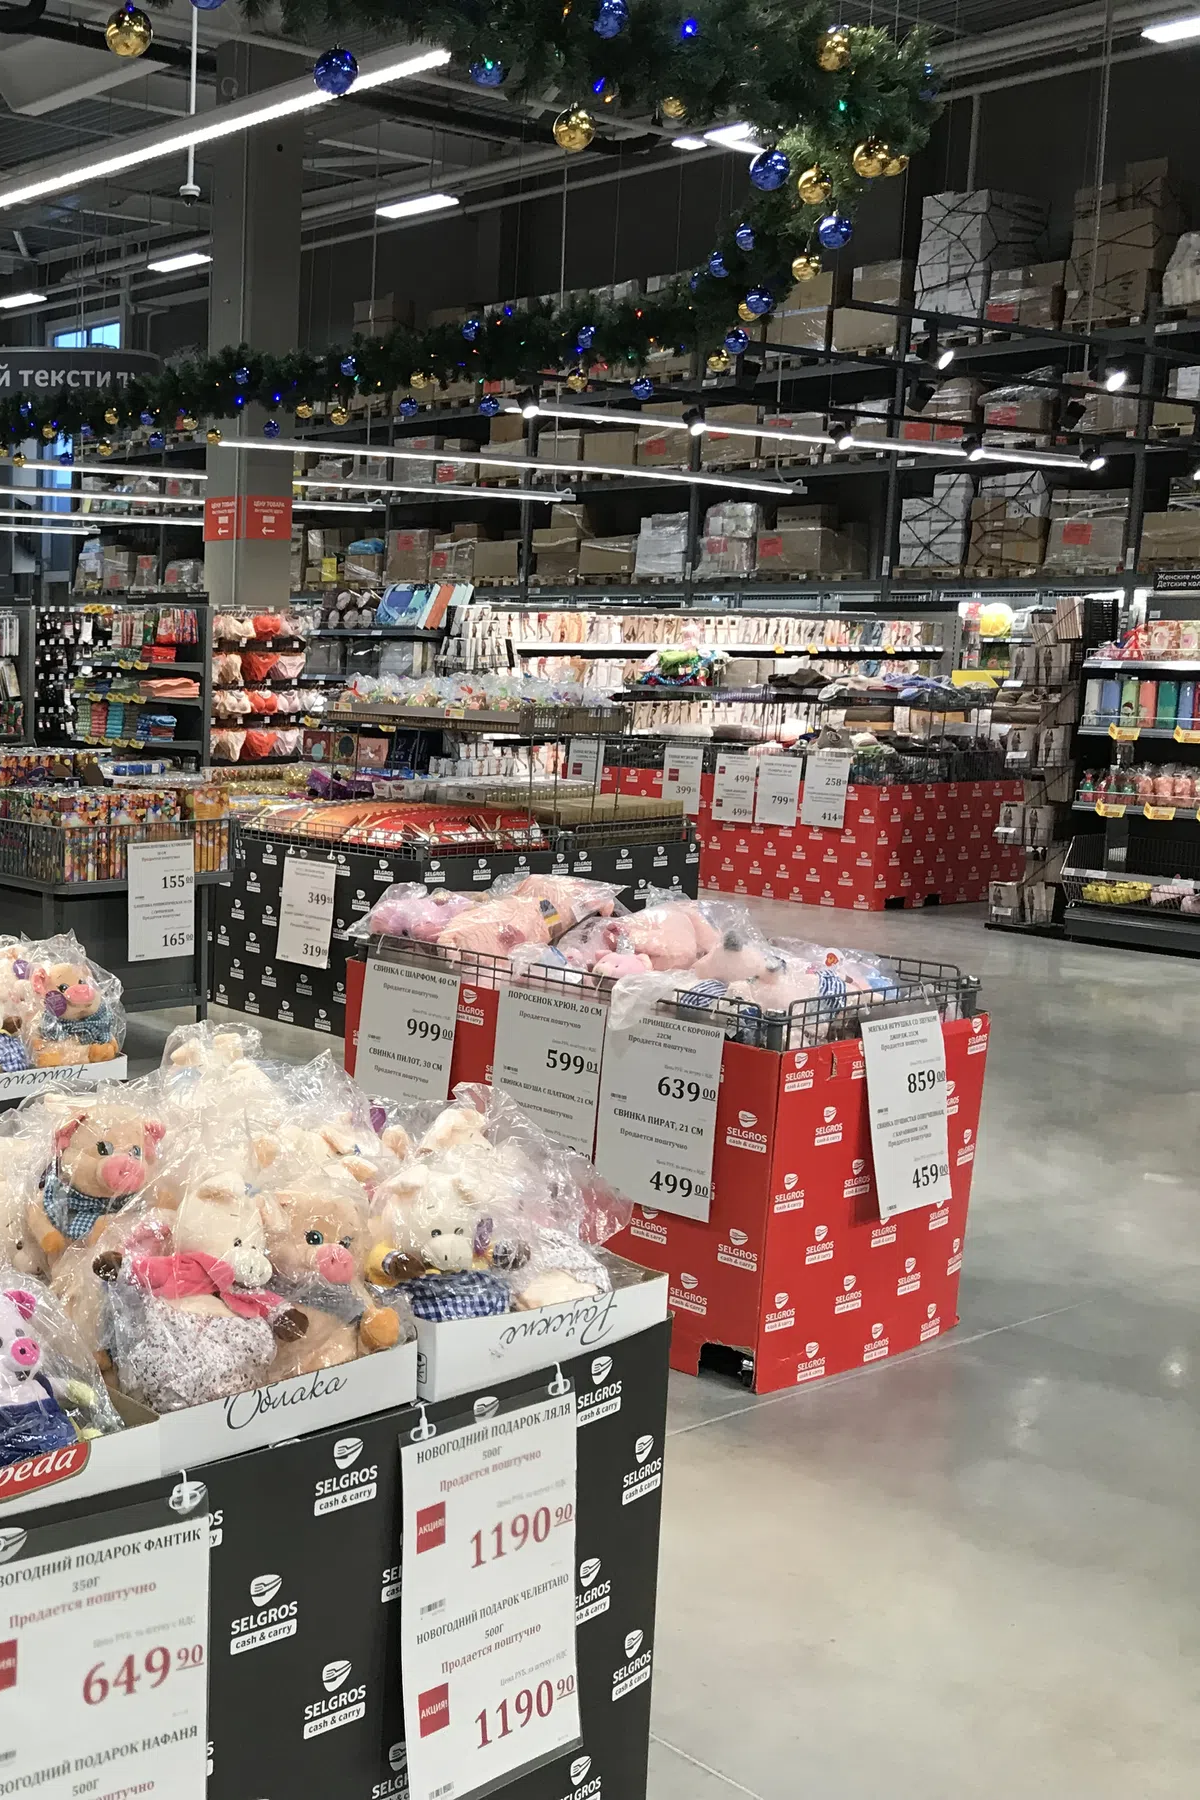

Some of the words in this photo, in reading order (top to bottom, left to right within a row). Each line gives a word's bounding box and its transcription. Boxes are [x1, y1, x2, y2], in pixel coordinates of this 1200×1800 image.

[19, 369, 135, 388] тексти
[1157, 580, 1187, 588] Детские
[825, 778, 841, 786] 258
[772, 796, 788, 805] 799
[162, 874, 185, 889] 155
[308, 892, 327, 906] 349
[163, 932, 185, 947] 165
[302, 943, 321, 957] 319
[374, 964, 399, 975] СВИНКА
[405, 970, 437, 984] ШАРФОМ,
[438, 977, 446, 985] 40
[448, 979, 457, 987] СМ
[508, 990, 552, 1007] ПОРОСЕНОК
[553, 1000, 578, 1012] ХРЮН,
[580, 1004, 589, 1014] 20
[591, 1007, 602, 1017] СМ
[407, 1018, 440, 1041] 999
[442, 1029, 453, 1040] 00
[519, 1010, 550, 1023] Продается
[551, 1017, 581, 1029] поштучно
[643, 1018, 681, 1031] ПРИНЦЕССА
[688, 1026, 721, 1039] КОРОНОЙ
[628, 1035, 662, 1047] Продается
[369, 1047, 395, 1060] СВИНКА
[397, 1054, 421, 1067] ПИЛОТ,
[423, 1060, 431, 1068] 30
[432, 1063, 442, 1072] СМ
[546, 1049, 584, 1075] 599
[586, 1061, 599, 1074] 01
[785, 1069, 814, 1081] SELGROS
[908, 1069, 935, 1093] 859
[937, 1071, 946, 1082] 00
[500, 1077, 522, 1088] СВИНКА
[523, 1082, 542, 1093] ШУША
[547, 1088, 576, 1102] ПЛАТКОМ,
[577, 1096, 584, 1104] 21
[585, 1098, 594, 1106] СМ
[658, 1076, 700, 1102] 639
[702, 1088, 716, 1101] 00
[614, 1108, 646, 1122] СВИНКА
[648, 1116, 678, 1131] ПИРАТ,
[679, 1124, 688, 1132] 21
[691, 1126, 703, 1136] СМ
[620, 1128, 653, 1142] Продается
[655, 1137, 687, 1150] поштучно
[727, 1126, 768, 1143] SELGROS
[748, 1142, 764, 1151] carry
[650, 1171, 692, 1198] 499
[694, 1185, 709, 1198] 00
[913, 1164, 938, 1188] 459
[940, 1164, 948, 1177] 00
[718, 1243, 758, 1262] SELGROS
[765, 1308, 795, 1322] SELGROS
[223, 1374, 348, 1430] Облака
[577, 1380, 622, 1409] SELGROS
[417, 1427, 489, 1464] НОВОГОДНИЙ
[491, 1413, 541, 1437] ПОДАРОК
[543, 1402, 571, 1422] ЛЯЛЯ
[315, 1465, 378, 1497] SELGROS
[440, 1465, 490, 1493] Продается
[492, 1450, 541, 1473] поштучно
[623, 1457, 662, 1488] SELGROS
[319, 1498, 339, 1511] cash
[341, 1494, 348, 1504] &
[349, 1487, 372, 1501] carry
[418, 1518, 445, 1536] АКЦИЯ!
[470, 1506, 551, 1569] 1190
[554, 1503, 573, 1527] 90
[75, 1542, 141, 1569] ПОДАРОК
[144, 1528, 202, 1552] ФАНТИК
[72, 1576, 101, 1593] 350Г
[9, 1597, 82, 1630] Продается
[86, 1581, 157, 1607] поштучно
[231, 1600, 298, 1635] SELGROS
[416, 1609, 478, 1645] НОВОГОДНИЙ
[480, 1594, 520, 1619] ПОДАРОК
[520, 1573, 569, 1601] ЧЕЛЕНТАНО
[235, 1636, 257, 1649] cash
[258, 1632, 266, 1642] &
[268, 1624, 293, 1639] carry
[484, 1623, 505, 1640] 500Г
[441, 1645, 492, 1674] Продается
[494, 1623, 541, 1650] поштучно
[82, 1646, 171, 1706] 649
[176, 1644, 204, 1670] 90
[304, 1684, 366, 1720] SELGROS
[421, 1699, 448, 1719] АКЦИЯ!
[475, 1679, 553, 1749] 1190
[557, 1674, 576, 1700] 90
[74, 1740, 139, 1772] ПОДАРОК
[141, 1725, 198, 1751] НАФАНЯ
[72, 1778, 100, 1797] 500Г
